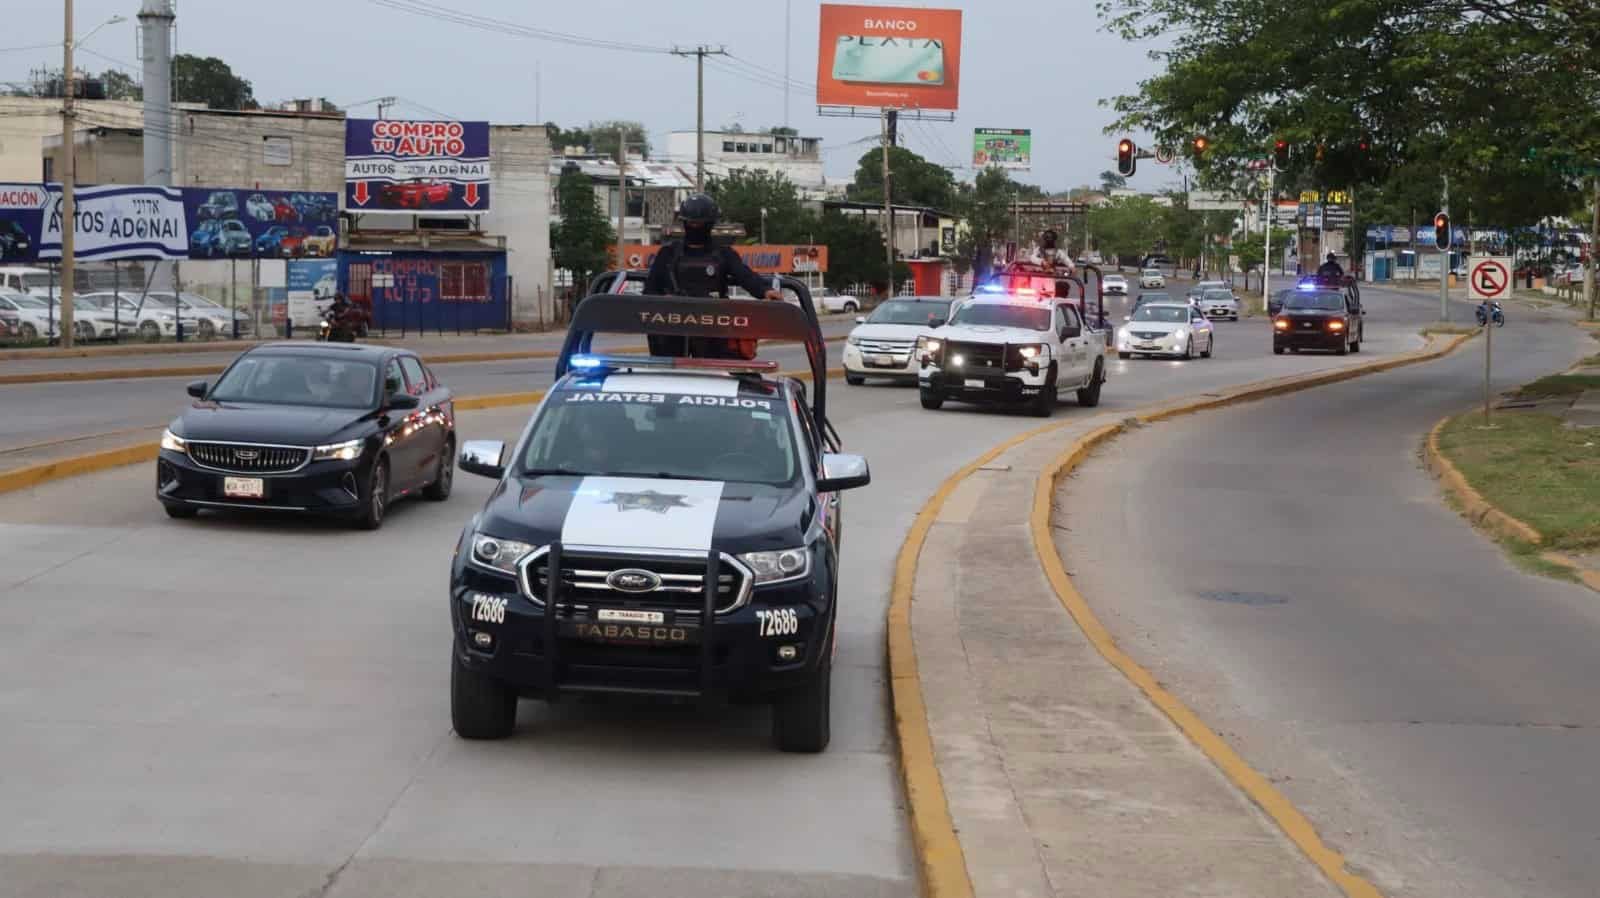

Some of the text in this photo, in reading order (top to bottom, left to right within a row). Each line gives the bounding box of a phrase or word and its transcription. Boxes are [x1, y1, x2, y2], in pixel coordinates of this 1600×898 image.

[864, 19, 917, 31] BANCO
[374, 121, 463, 138] COMPRO
[373, 138, 465, 156] TU AUTO
[352, 163, 396, 175] AUTOS
[428, 164, 485, 176] ADONAI
[0, 188, 38, 206] ACIÓN
[48, 210, 178, 239] ATOS ADONAI
[639, 311, 749, 328] TABASCO
[471, 594, 508, 625] 72686
[755, 607, 798, 637] 72686
[575, 624, 686, 642] TABASCO
